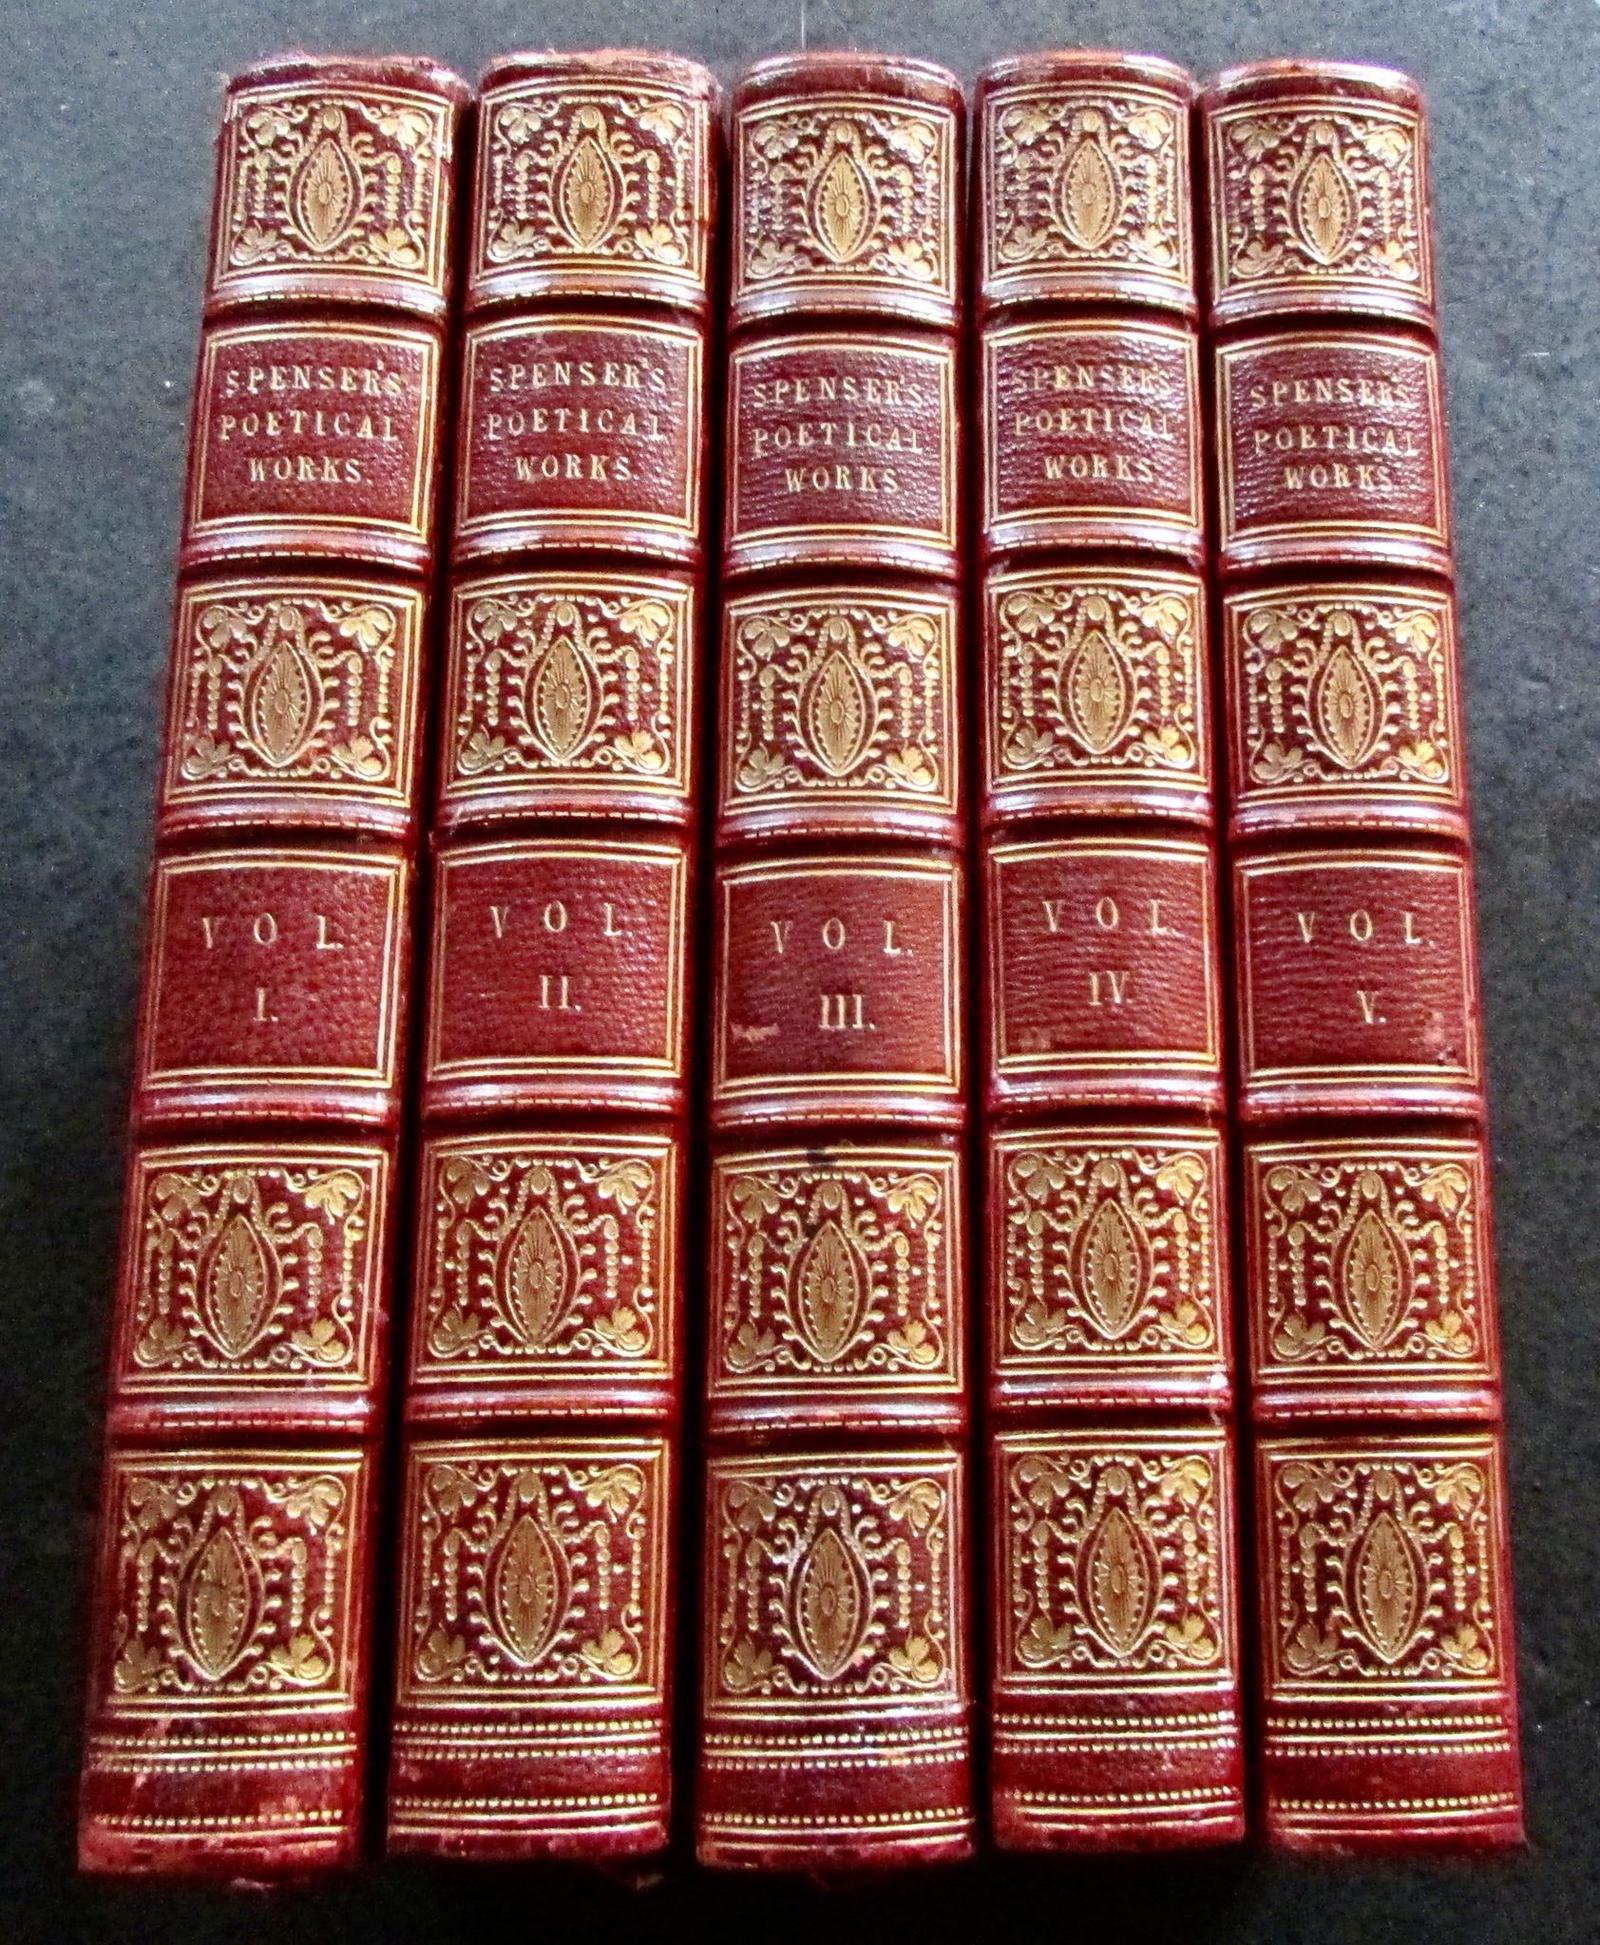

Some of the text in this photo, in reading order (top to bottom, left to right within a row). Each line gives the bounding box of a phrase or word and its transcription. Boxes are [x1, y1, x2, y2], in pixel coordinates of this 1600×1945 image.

[225, 359, 403, 398] SPENSER'S
[489, 357, 667, 393] SPENSER'S
[217, 409, 400, 442] POETICAL
[484, 407, 667, 441] POETICAL
[752, 421, 923, 458] POETICAL
[1014, 407, 1173, 440] POETICAL
[1254, 424, 1418, 456] POETICAL
[818, 993, 877, 1031] III.
